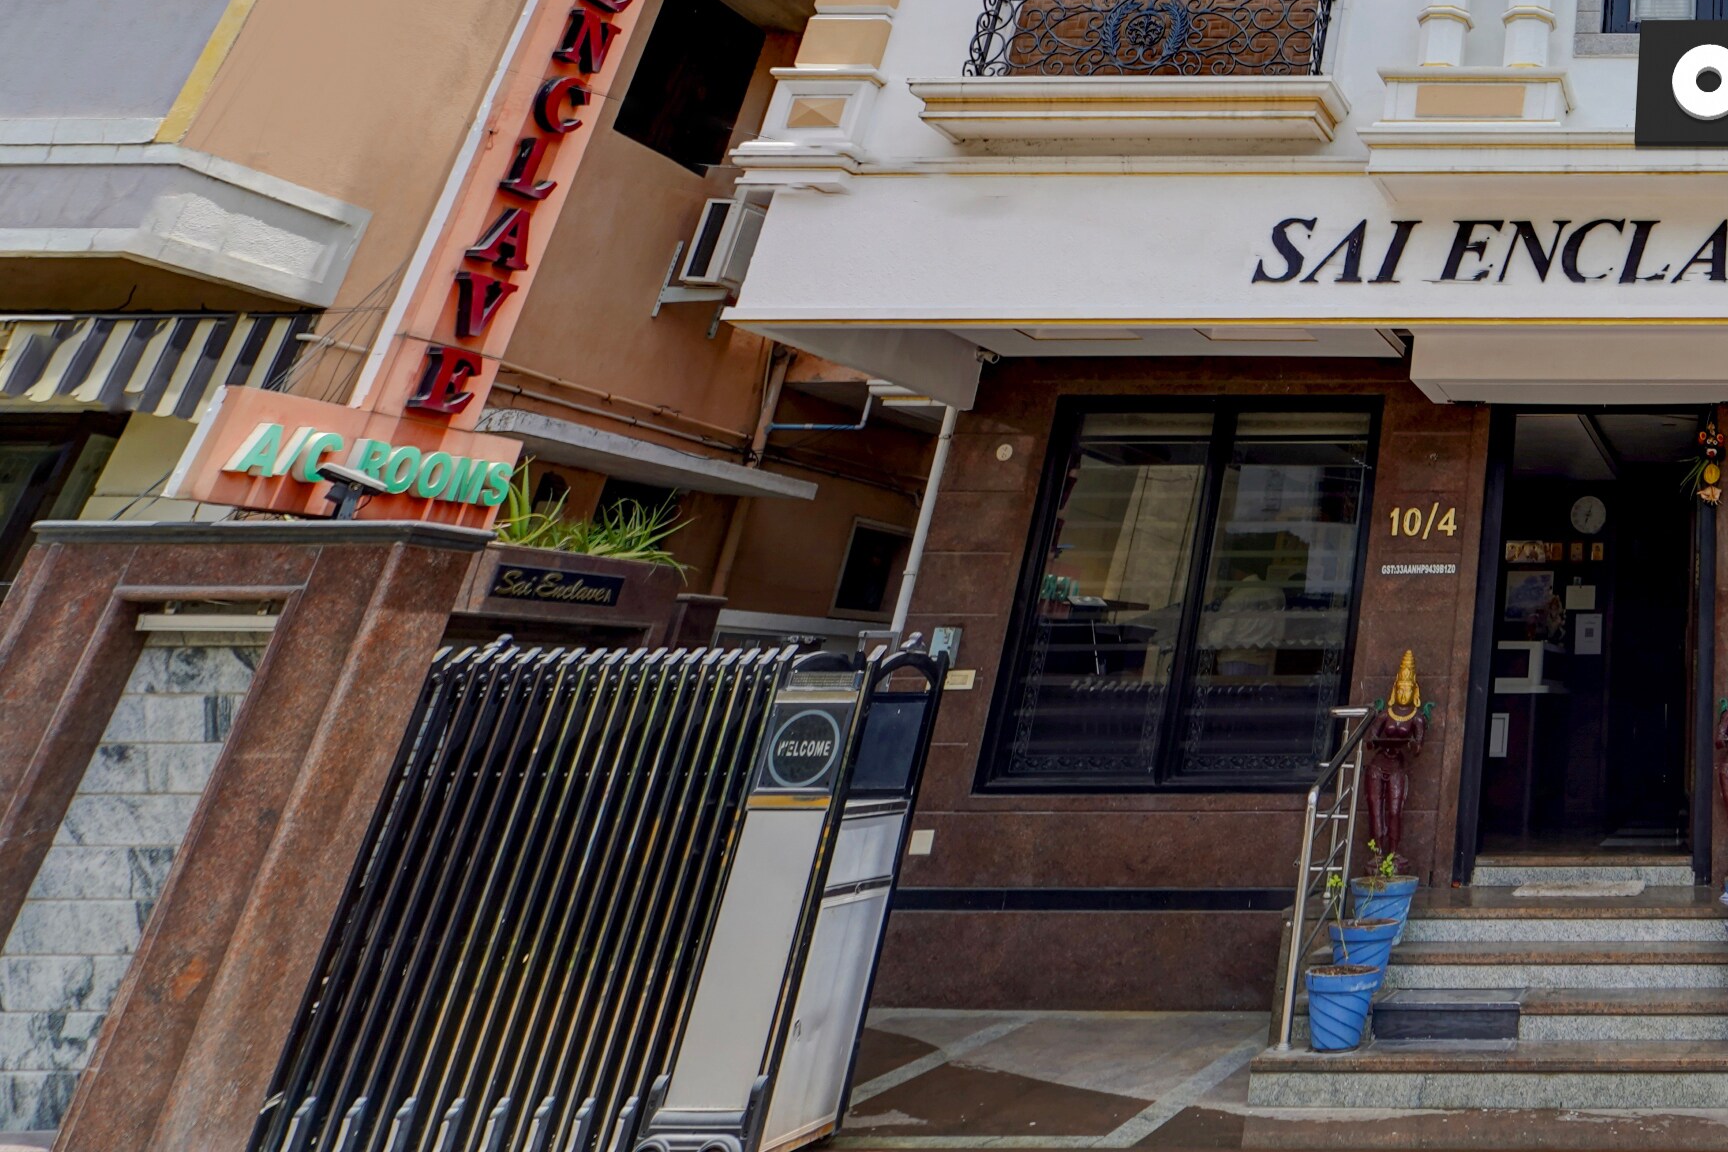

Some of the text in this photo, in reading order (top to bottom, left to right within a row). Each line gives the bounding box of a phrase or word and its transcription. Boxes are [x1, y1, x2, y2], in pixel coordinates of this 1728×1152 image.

[1251, 217, 1423, 284] SAI
[224, 423, 513, 507] A/C ROOMS
[1389, 502, 1458, 540] 10/4
[494, 569, 537, 596] Sai
[777, 740, 832, 757] WELCOME
